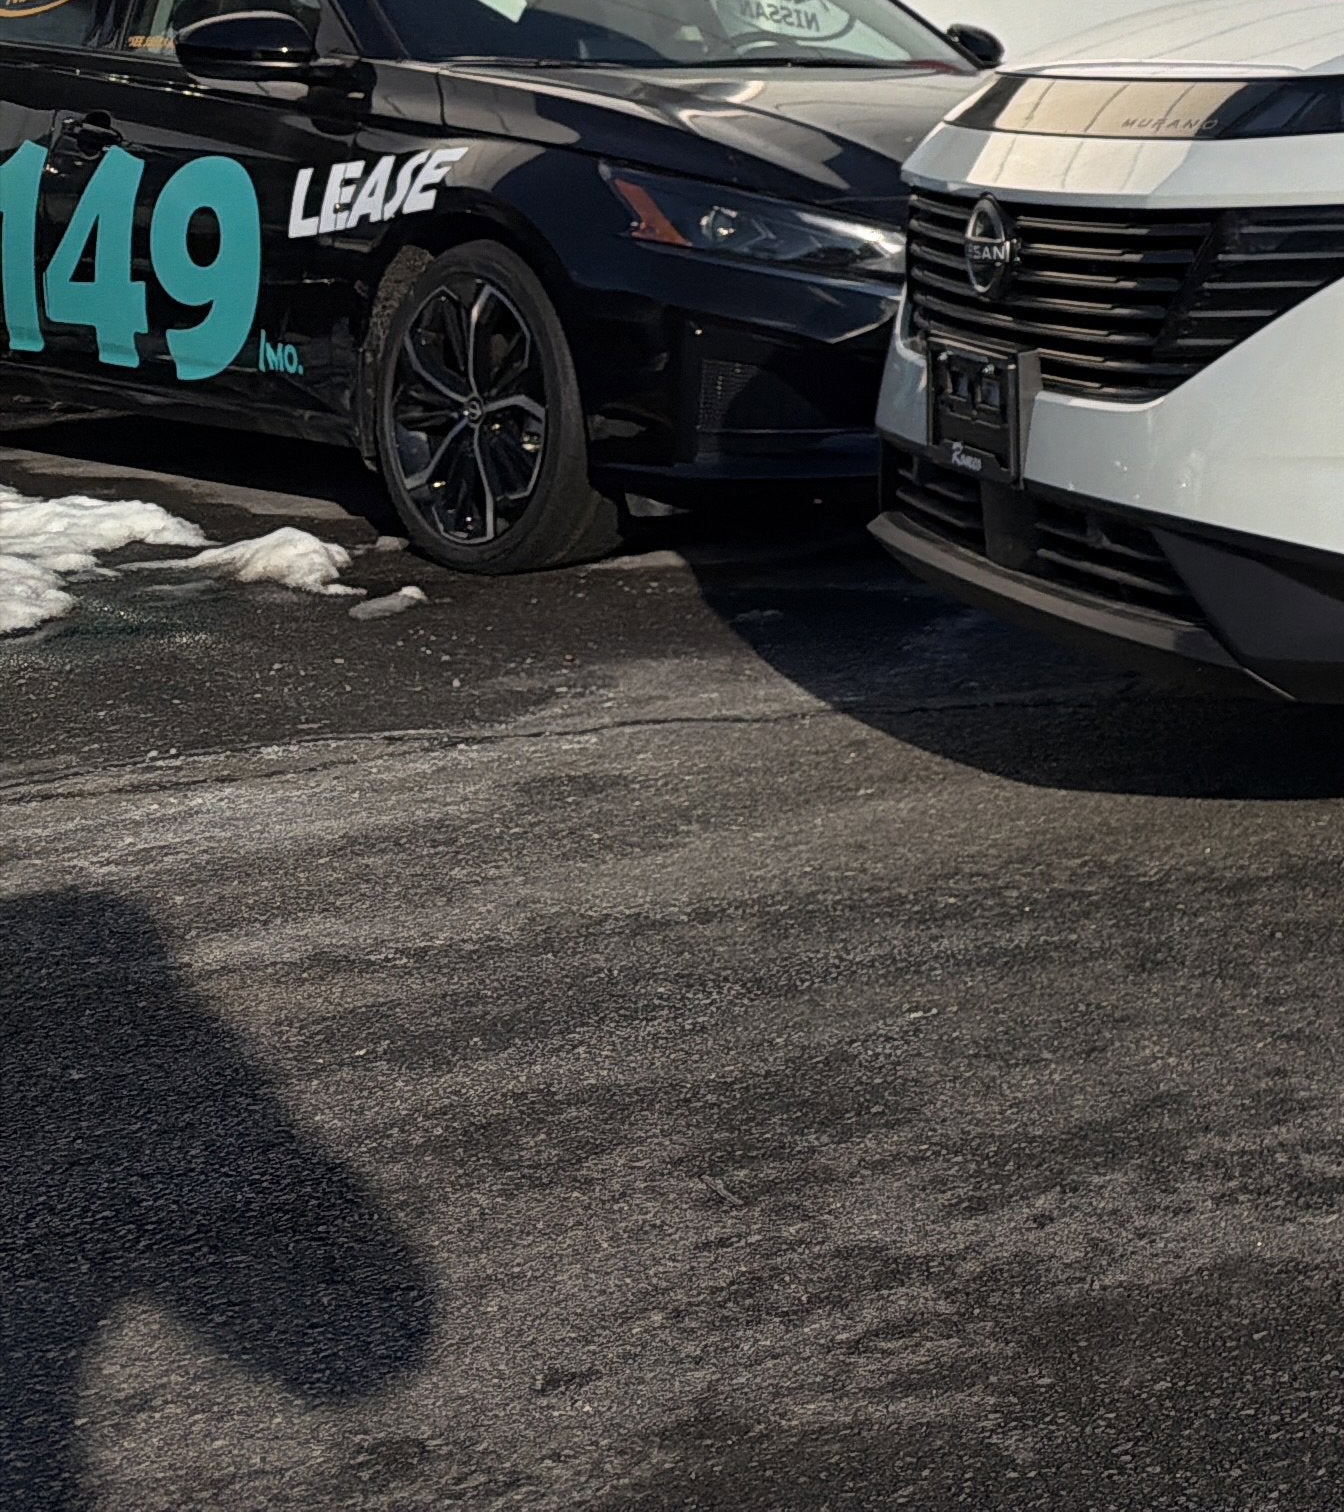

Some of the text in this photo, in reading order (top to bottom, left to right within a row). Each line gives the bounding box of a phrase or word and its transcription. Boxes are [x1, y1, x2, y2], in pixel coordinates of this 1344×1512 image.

[1121, 117, 1221, 132] MURANO
[288, 146, 469, 239] LEASE
[0, 139, 261, 380] 149
